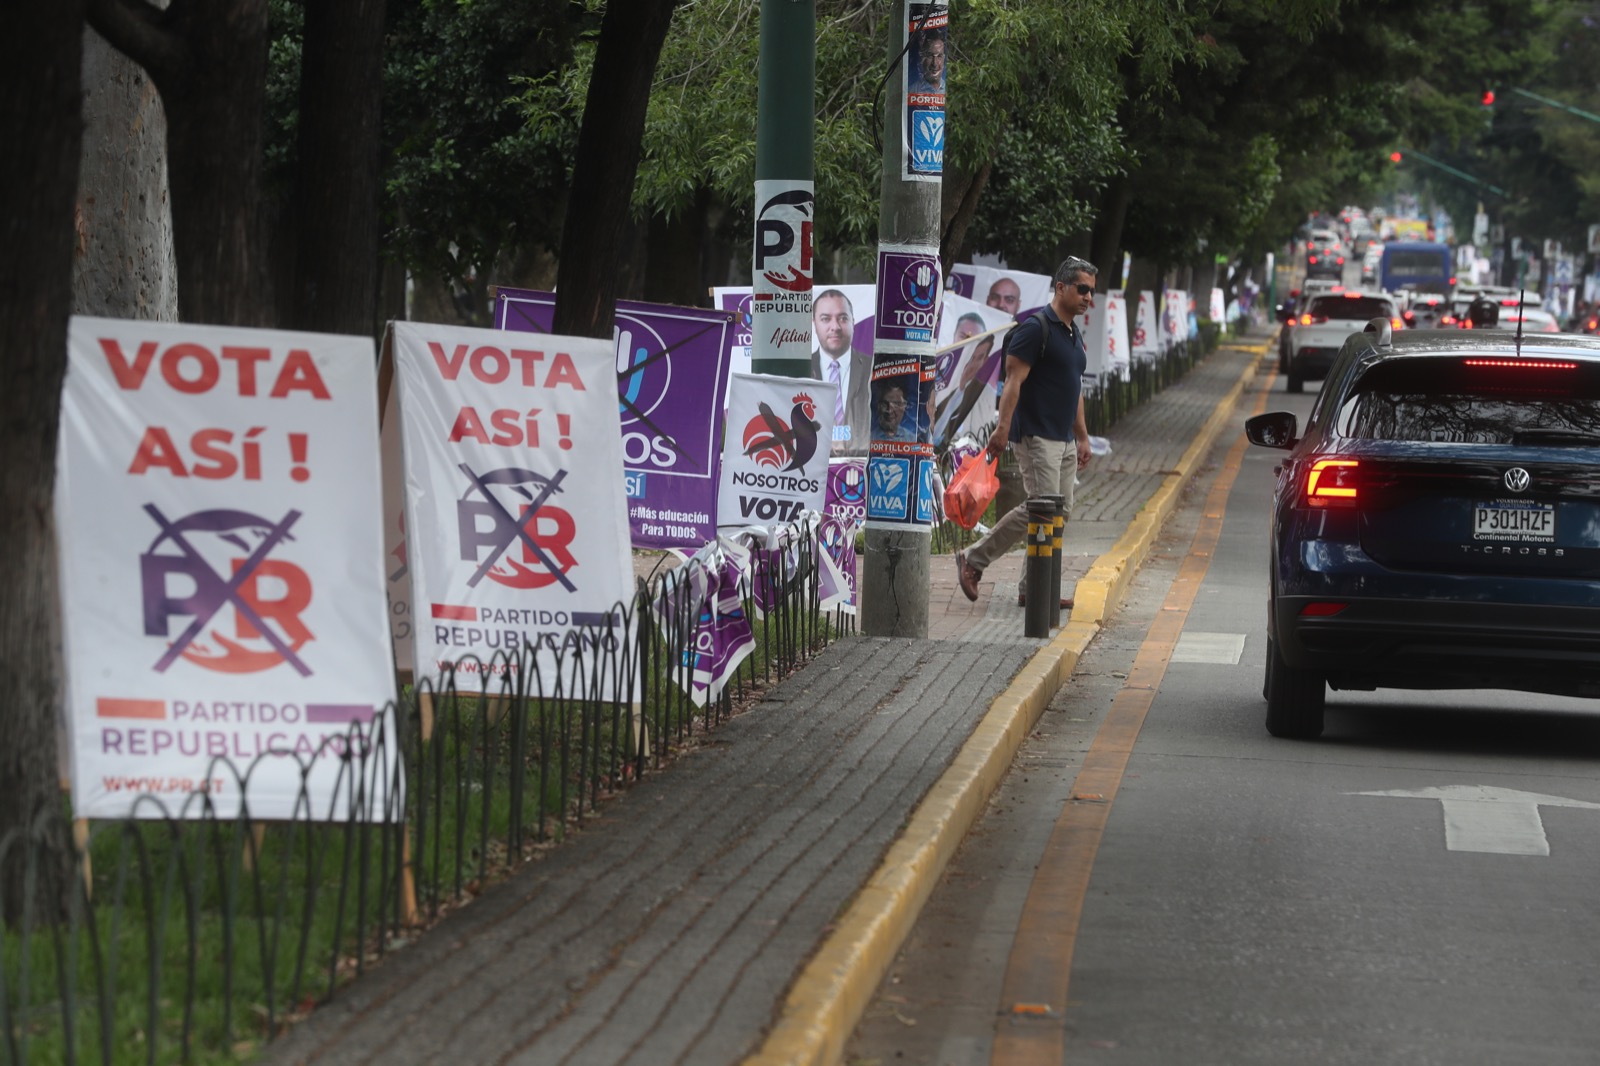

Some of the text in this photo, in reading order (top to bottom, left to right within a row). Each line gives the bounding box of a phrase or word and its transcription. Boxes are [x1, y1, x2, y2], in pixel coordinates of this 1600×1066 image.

[775, 293, 812, 301] PARTIDO
[906, 331, 920, 340] VOTA
[98, 337, 332, 400] VOTA
[427, 341, 587, 392] VOTA
[874, 364, 916, 379] NACIONAL
[871, 443, 910, 452] PORTILLO
[733, 471, 819, 493] NOSOTROS
[739, 495, 805, 523] VOTA
[871, 496, 904, 511] VIVA
[630, 506, 709, 525] #Más educación
[1478, 509, 1552, 531] P301HZF
[642, 523, 697, 539] Para TODOS
[1473, 533, 1555, 543] Continental Motores
[1461, 544, 1564, 557] T-CROSS
[480, 607, 569, 626] PARTIDO
[435, 625, 619, 653] REPUBLICANO
[173, 700, 300, 724] PARTIDO
[101, 728, 373, 759] REPUBLICANO
